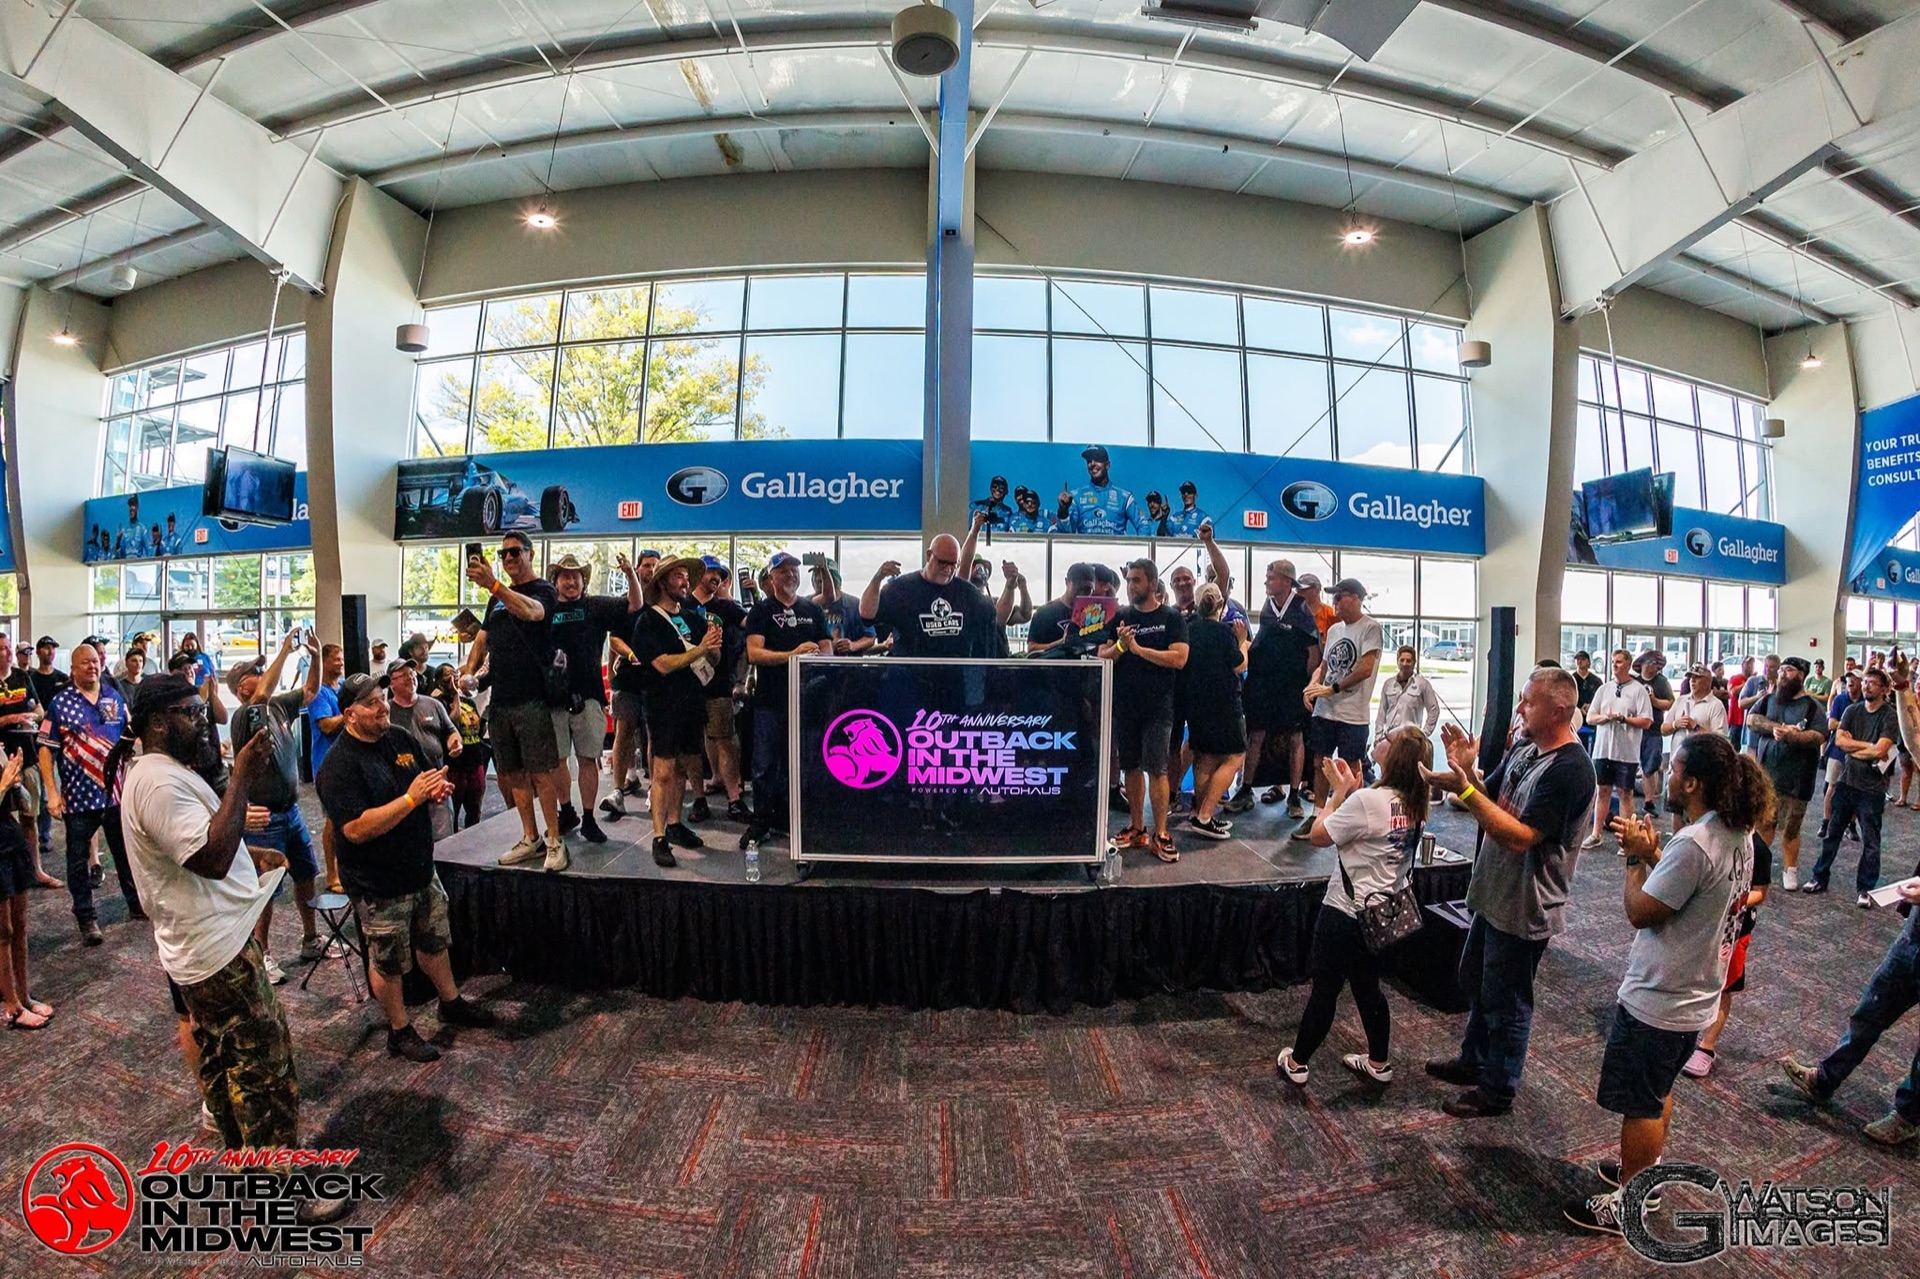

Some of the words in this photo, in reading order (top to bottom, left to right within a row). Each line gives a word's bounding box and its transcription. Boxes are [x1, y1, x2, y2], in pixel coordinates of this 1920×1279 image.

[1865, 437, 1898, 453] YOUR
[1866, 450, 1920, 470] BENEFITS
[1868, 468, 1920, 487] CONSULT
[741, 472, 904, 504] Gallagher
[621, 502, 639, 517] EXIT
[1348, 492, 1472, 528] Gallagher
[1248, 511, 1266, 527] EXIT
[1718, 536, 1779, 564] Gallagher
[925, 621, 942, 629] USED
[906, 708, 956, 731] 10TH
[960, 712, 1053, 729] ANNIVERSARY
[907, 731, 1077, 750] OUTBACK
[907, 749, 942, 767] IN
[949, 749, 1016, 767] THE
[907, 767, 1069, 785] MIDWEST
[980, 786, 1061, 796] AUTOHAUS
